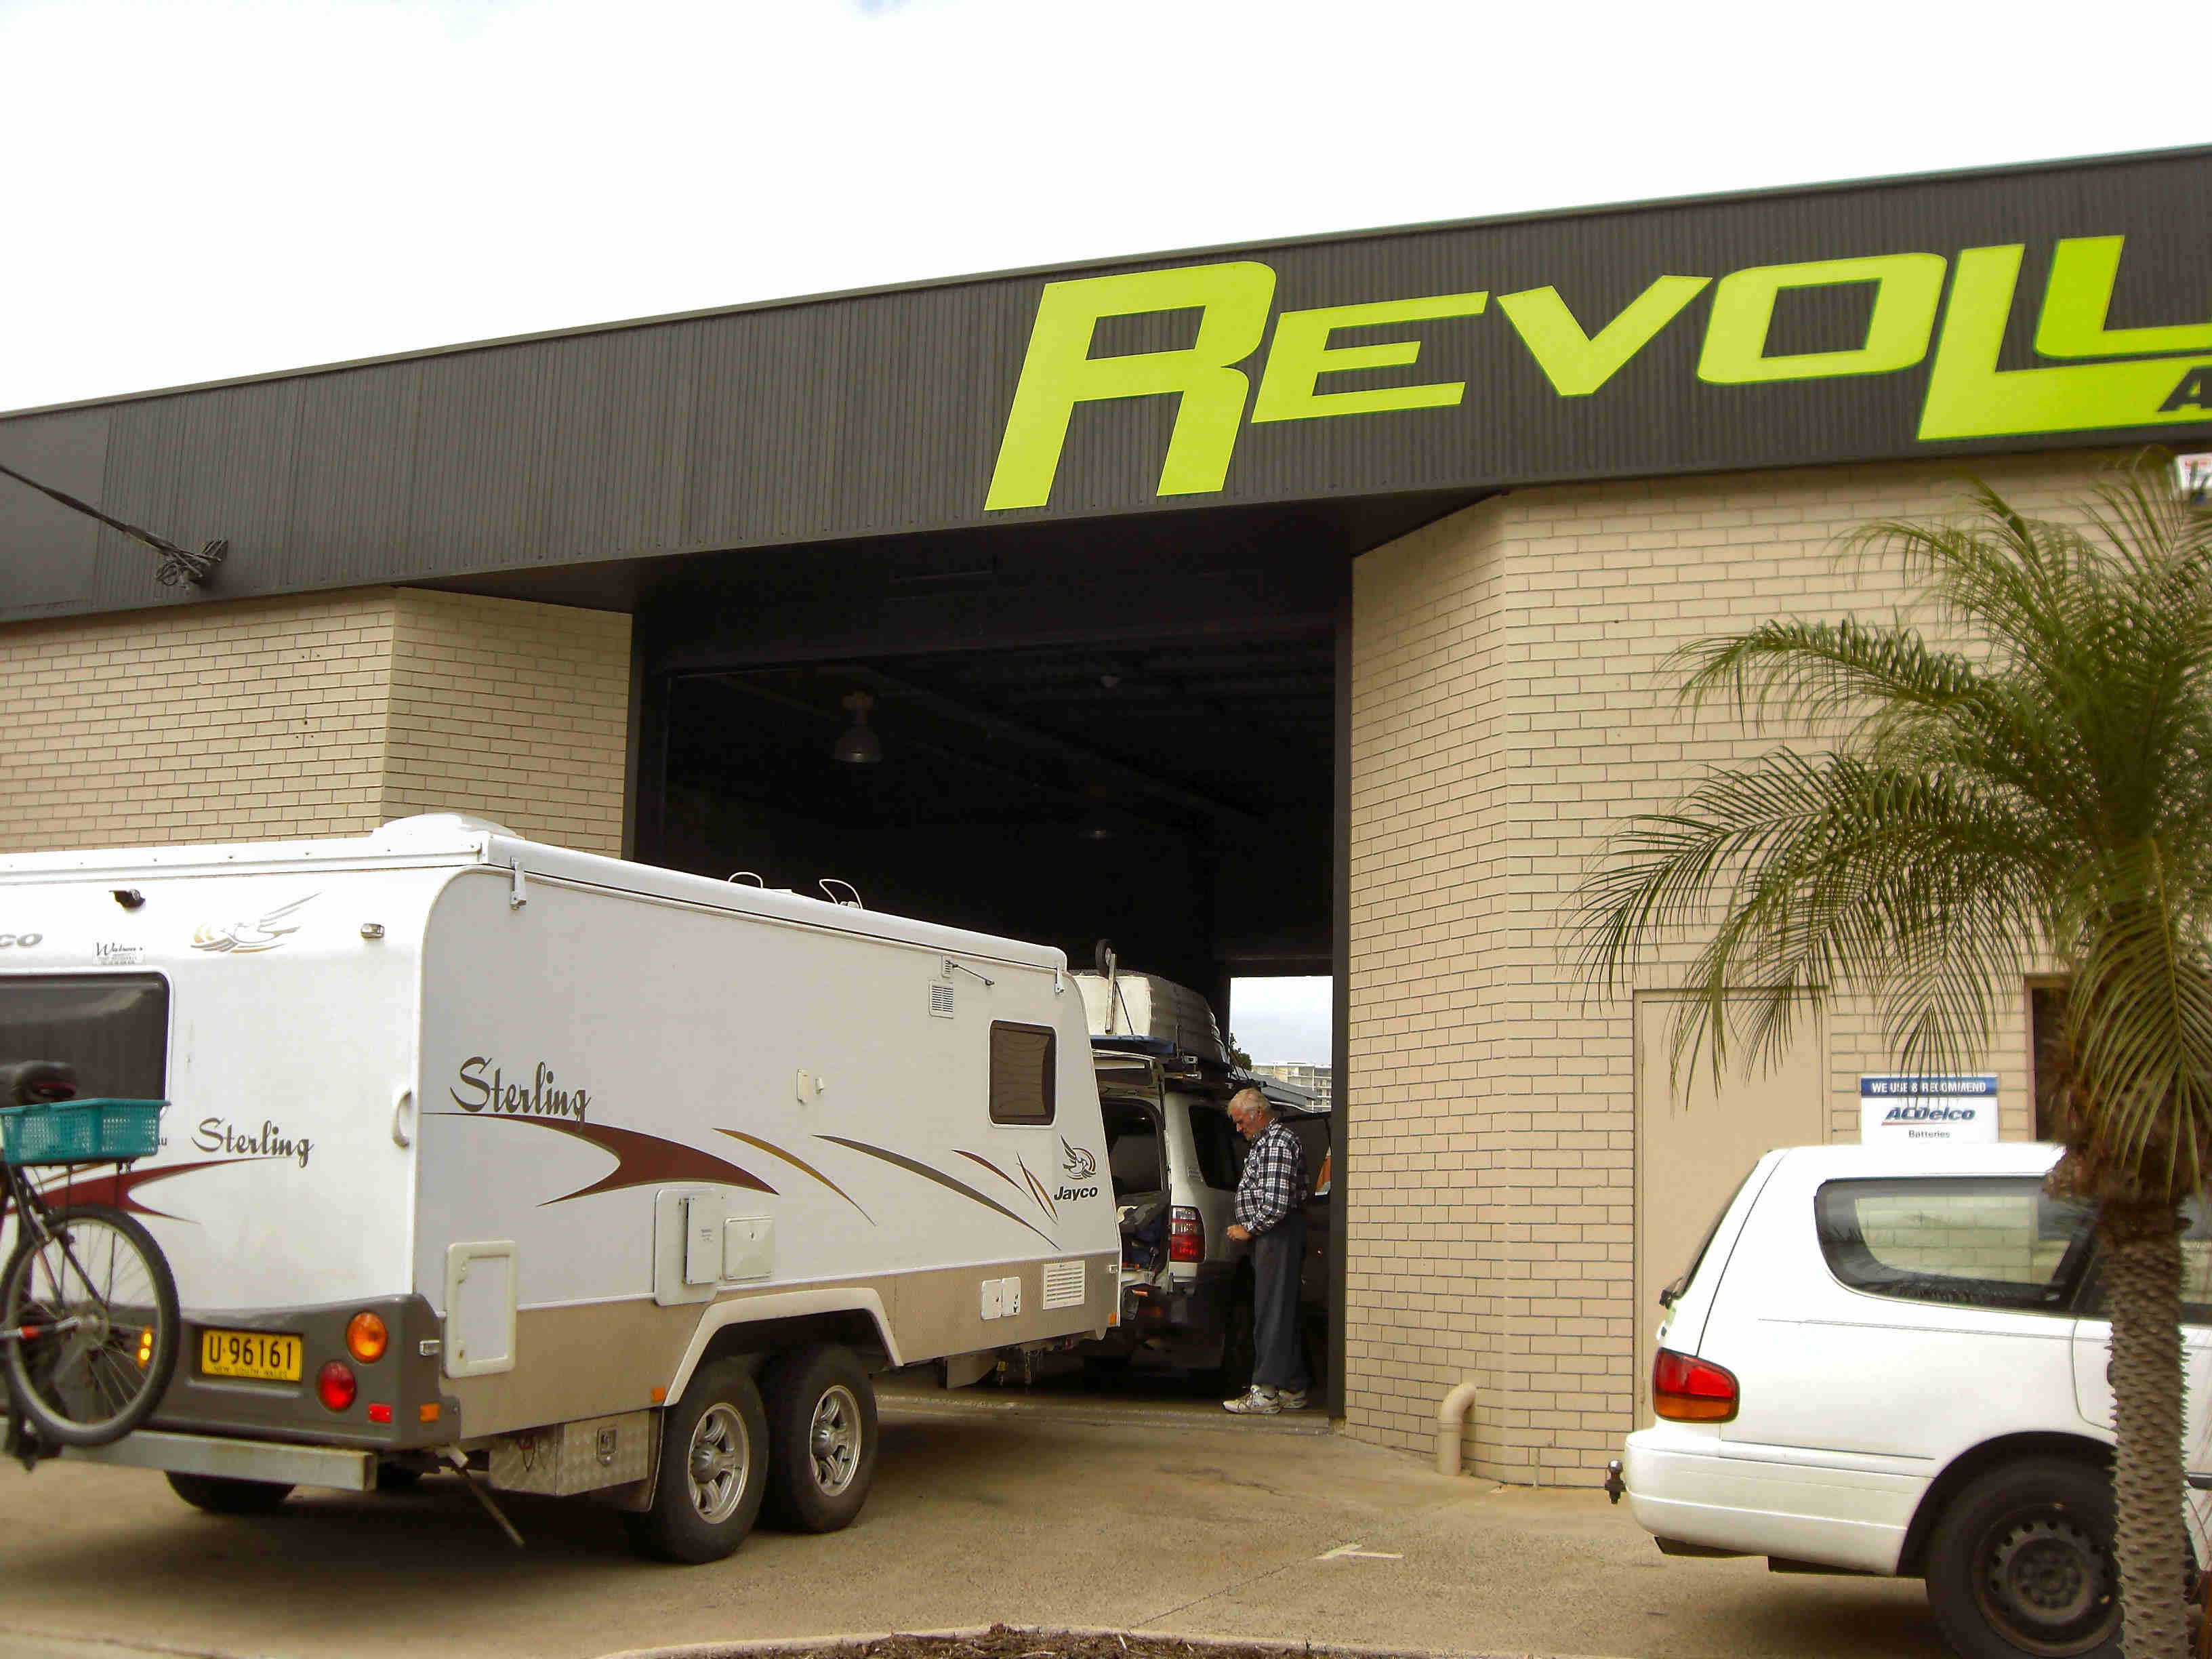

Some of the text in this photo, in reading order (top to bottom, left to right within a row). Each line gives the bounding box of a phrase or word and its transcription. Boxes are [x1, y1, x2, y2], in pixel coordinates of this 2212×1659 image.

[450, 1057, 592, 1132] Sterling
[1872, 1082, 1887, 1093] WE
[1922, 1082, 1986, 1092] RECOMMEND
[1885, 1105, 1976, 1122] ACDelco
[1908, 1130, 1950, 1139] Batteries
[191, 1118, 314, 1168] Sterling
[1054, 1186, 1098, 1202] Jayco
